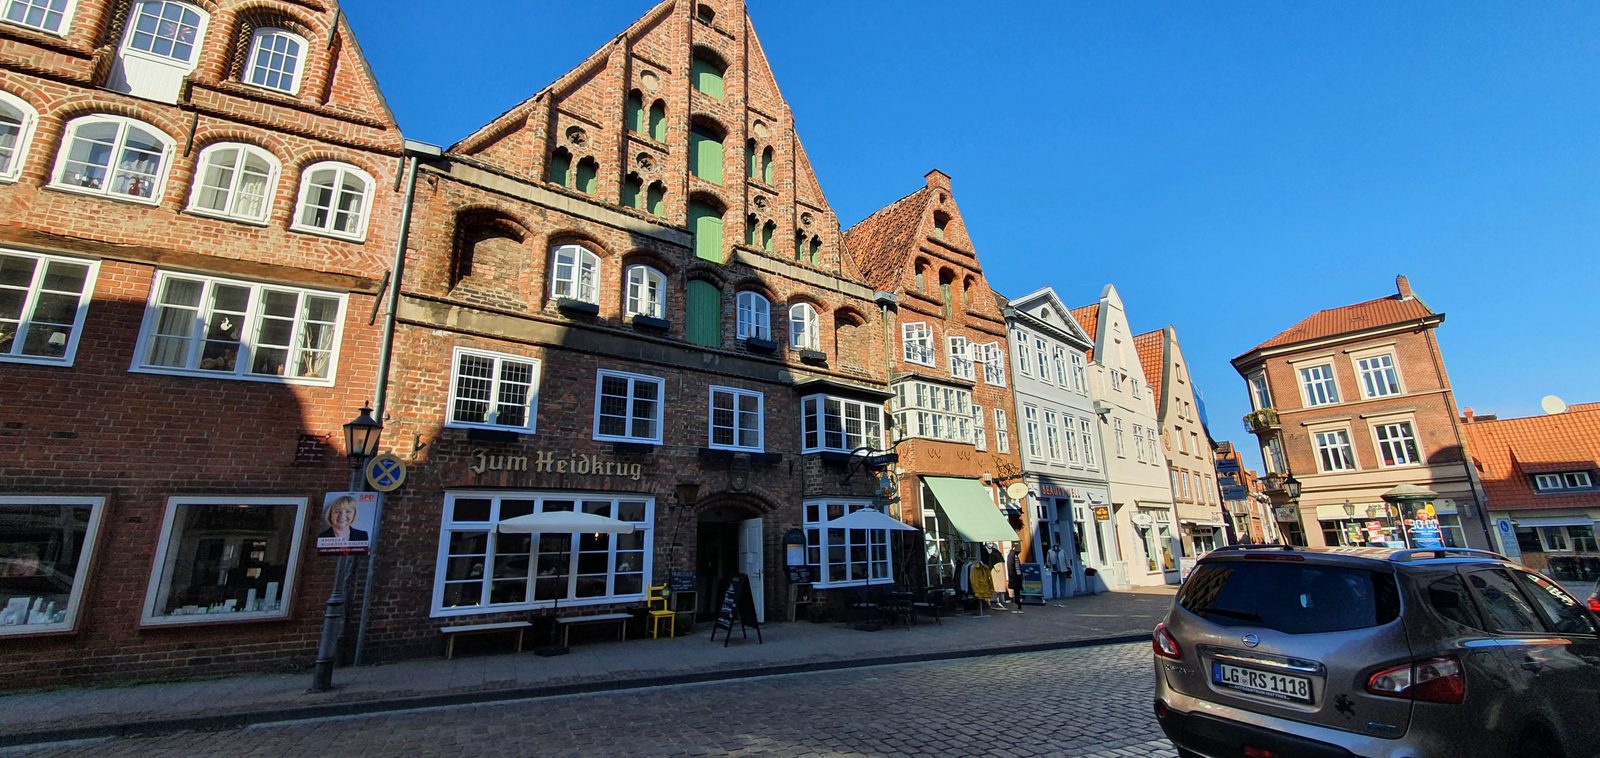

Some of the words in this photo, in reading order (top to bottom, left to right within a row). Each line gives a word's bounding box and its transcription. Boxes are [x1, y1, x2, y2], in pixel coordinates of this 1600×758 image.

[470, 447, 528, 475] Zum
[535, 449, 642, 481] Heidkrug
[1222, 666, 1240, 684] LG
[1249, 671, 1268, 689] RS
[1270, 675, 1308, 697] 1118
